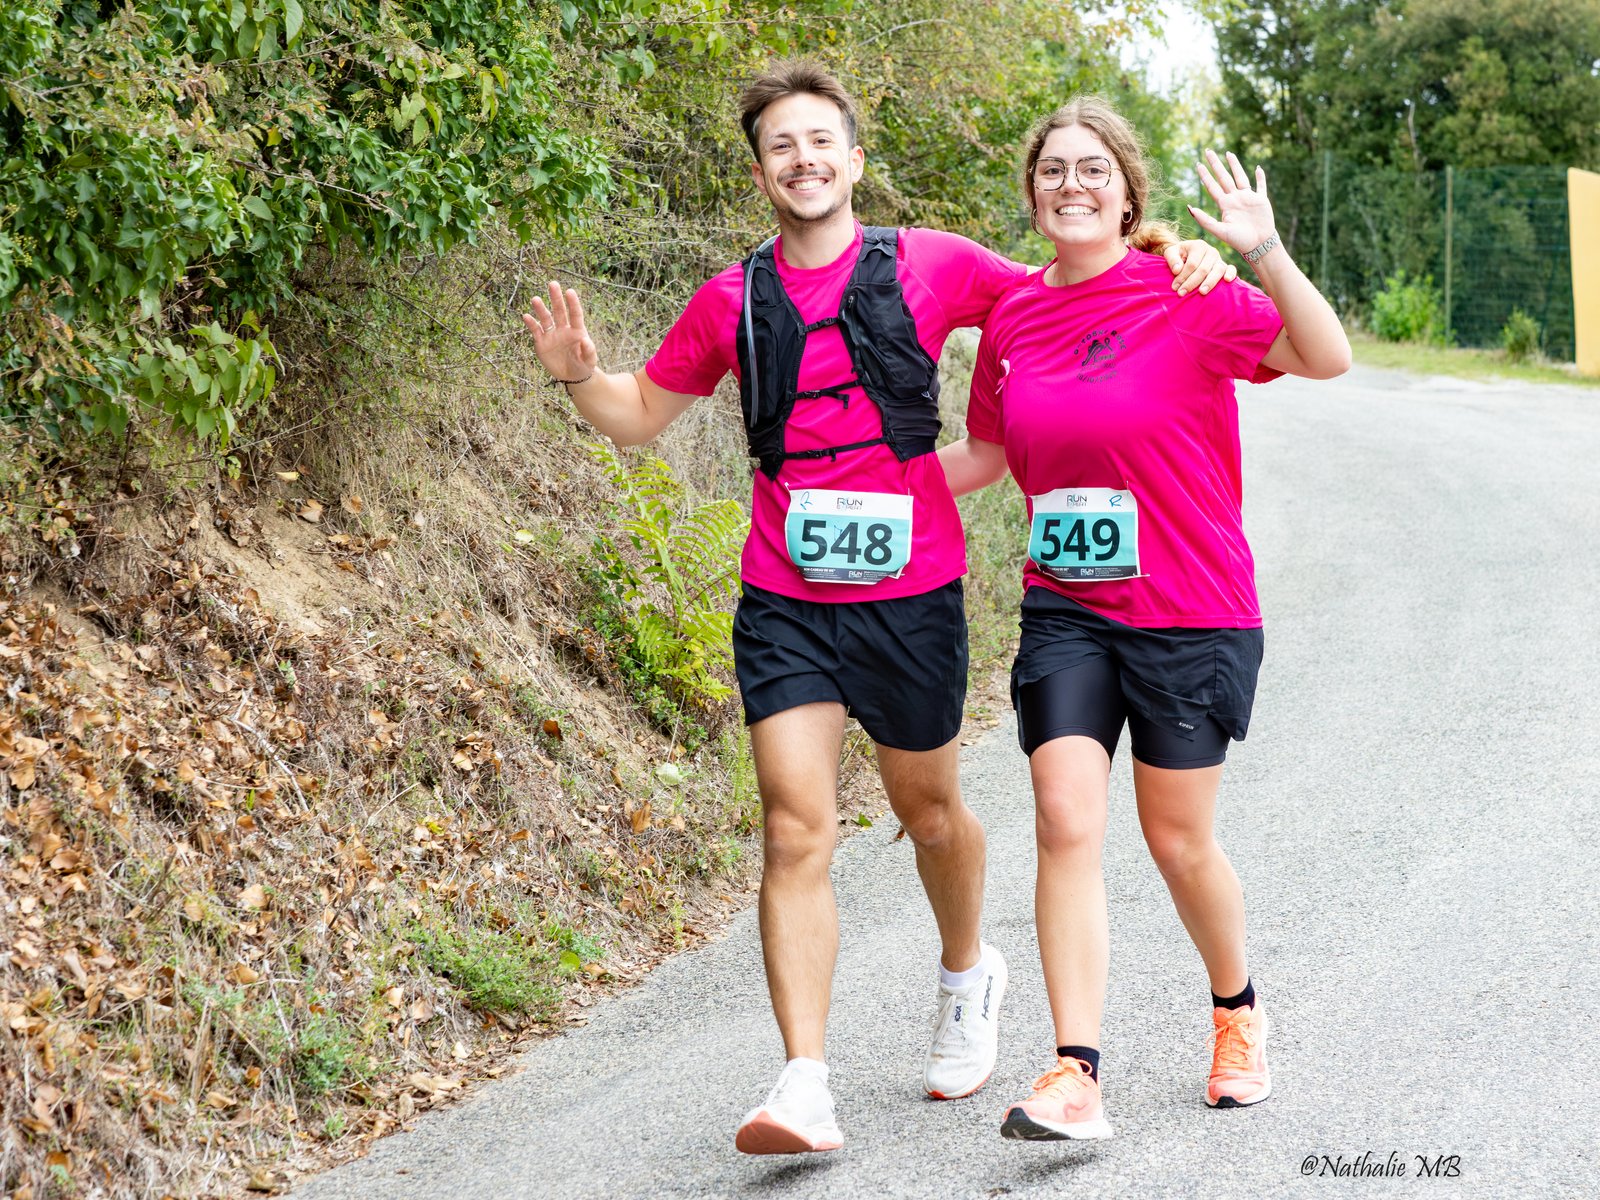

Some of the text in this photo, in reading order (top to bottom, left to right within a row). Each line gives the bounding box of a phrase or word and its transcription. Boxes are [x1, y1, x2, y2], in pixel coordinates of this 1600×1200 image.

[836, 497, 863, 506] RUN
[1066, 494, 1087, 503] RUN
[800, 519, 893, 566] 548
[1040, 518, 1120, 562] 549
[981, 975, 993, 1020] HOKA
